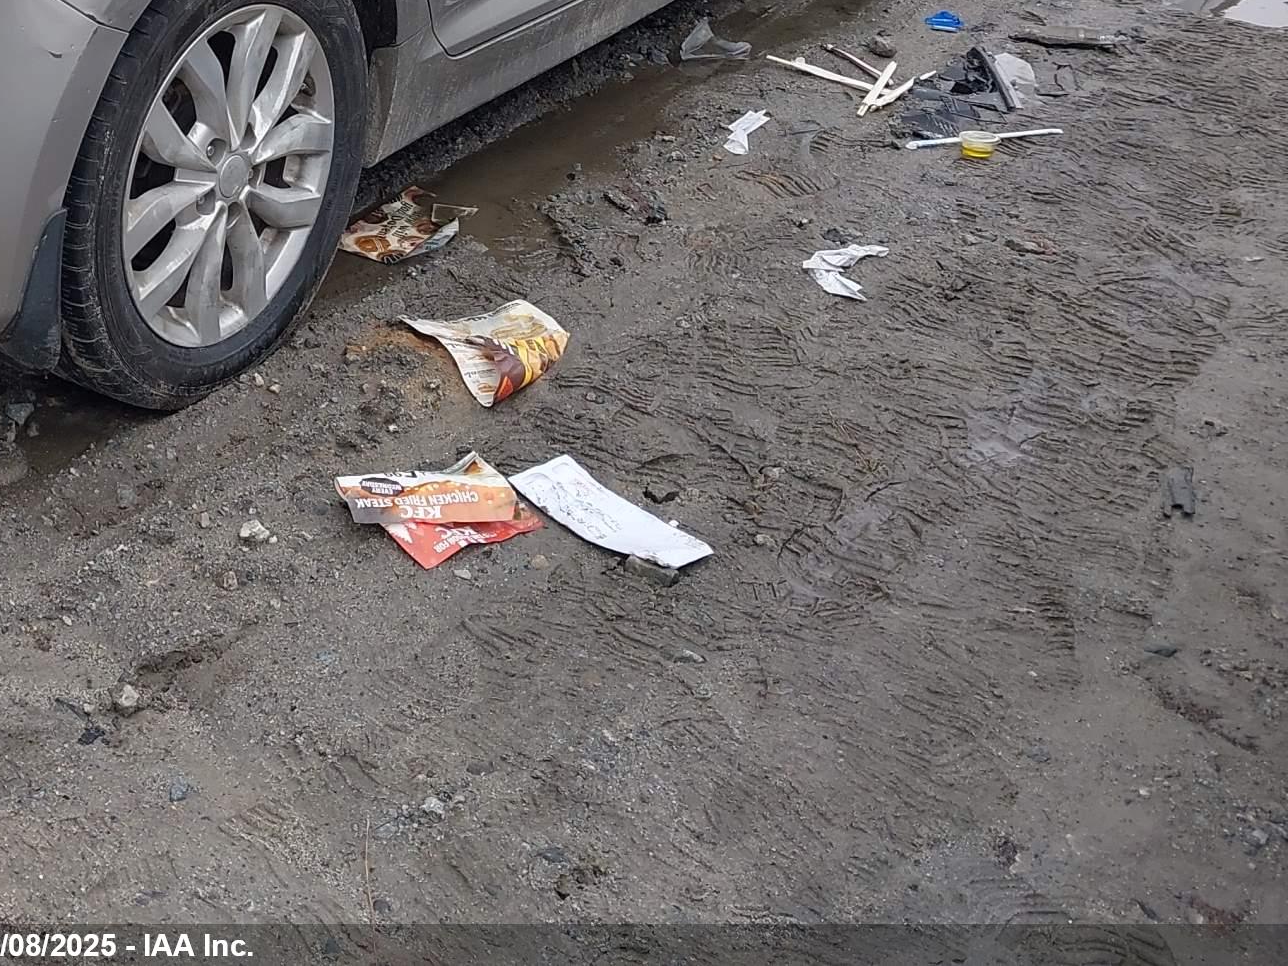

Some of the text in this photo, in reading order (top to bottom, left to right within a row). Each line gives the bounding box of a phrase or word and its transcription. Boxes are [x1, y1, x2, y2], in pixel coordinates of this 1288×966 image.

[372, 486, 394, 495] EVERY
[355, 490, 480, 509] CHICKEN FRIED STEAK
[401, 506, 442, 519] KFC
